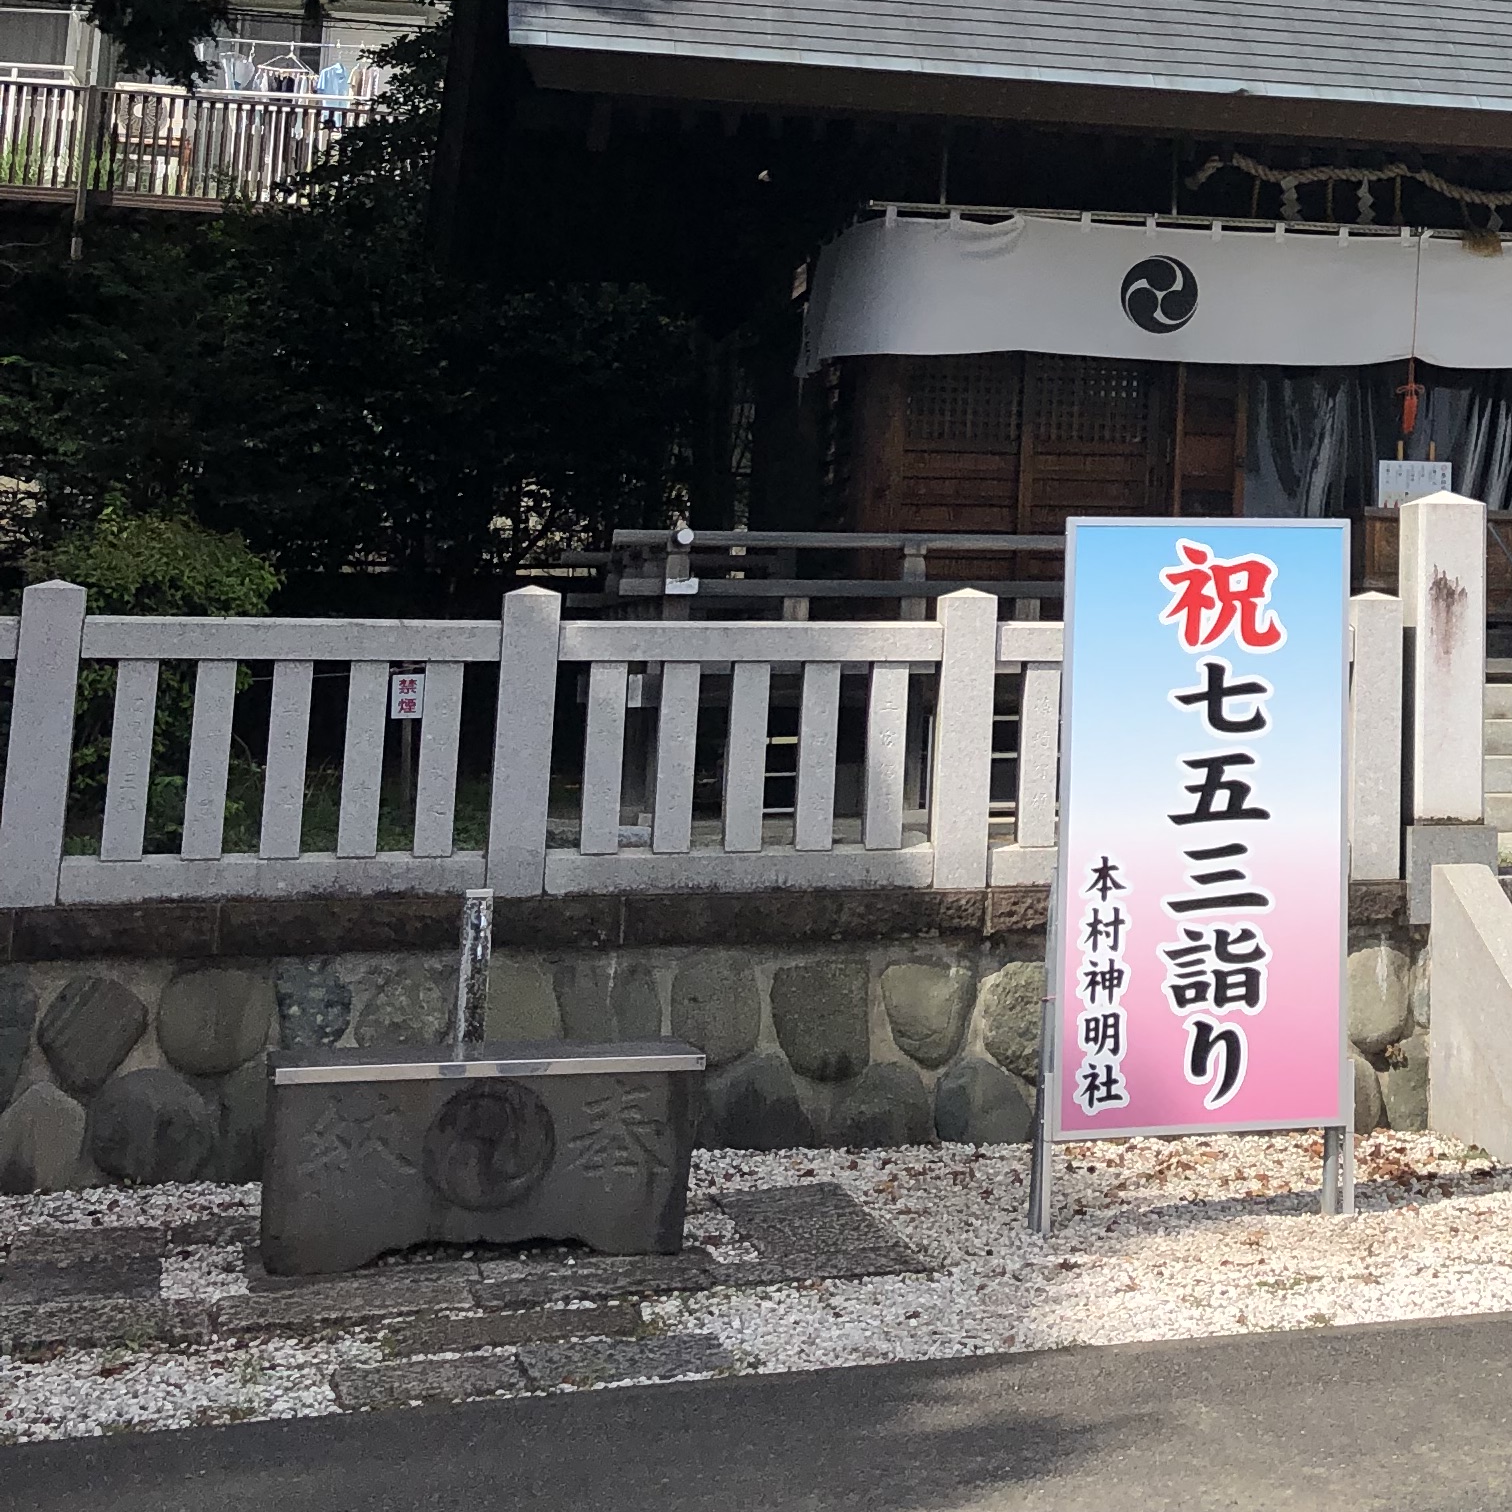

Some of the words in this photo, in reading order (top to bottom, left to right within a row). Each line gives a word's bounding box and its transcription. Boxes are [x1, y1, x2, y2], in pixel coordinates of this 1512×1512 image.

[398, 678, 417, 714] 禁煙
[1080, 856, 1127, 1108] 本村神明社
